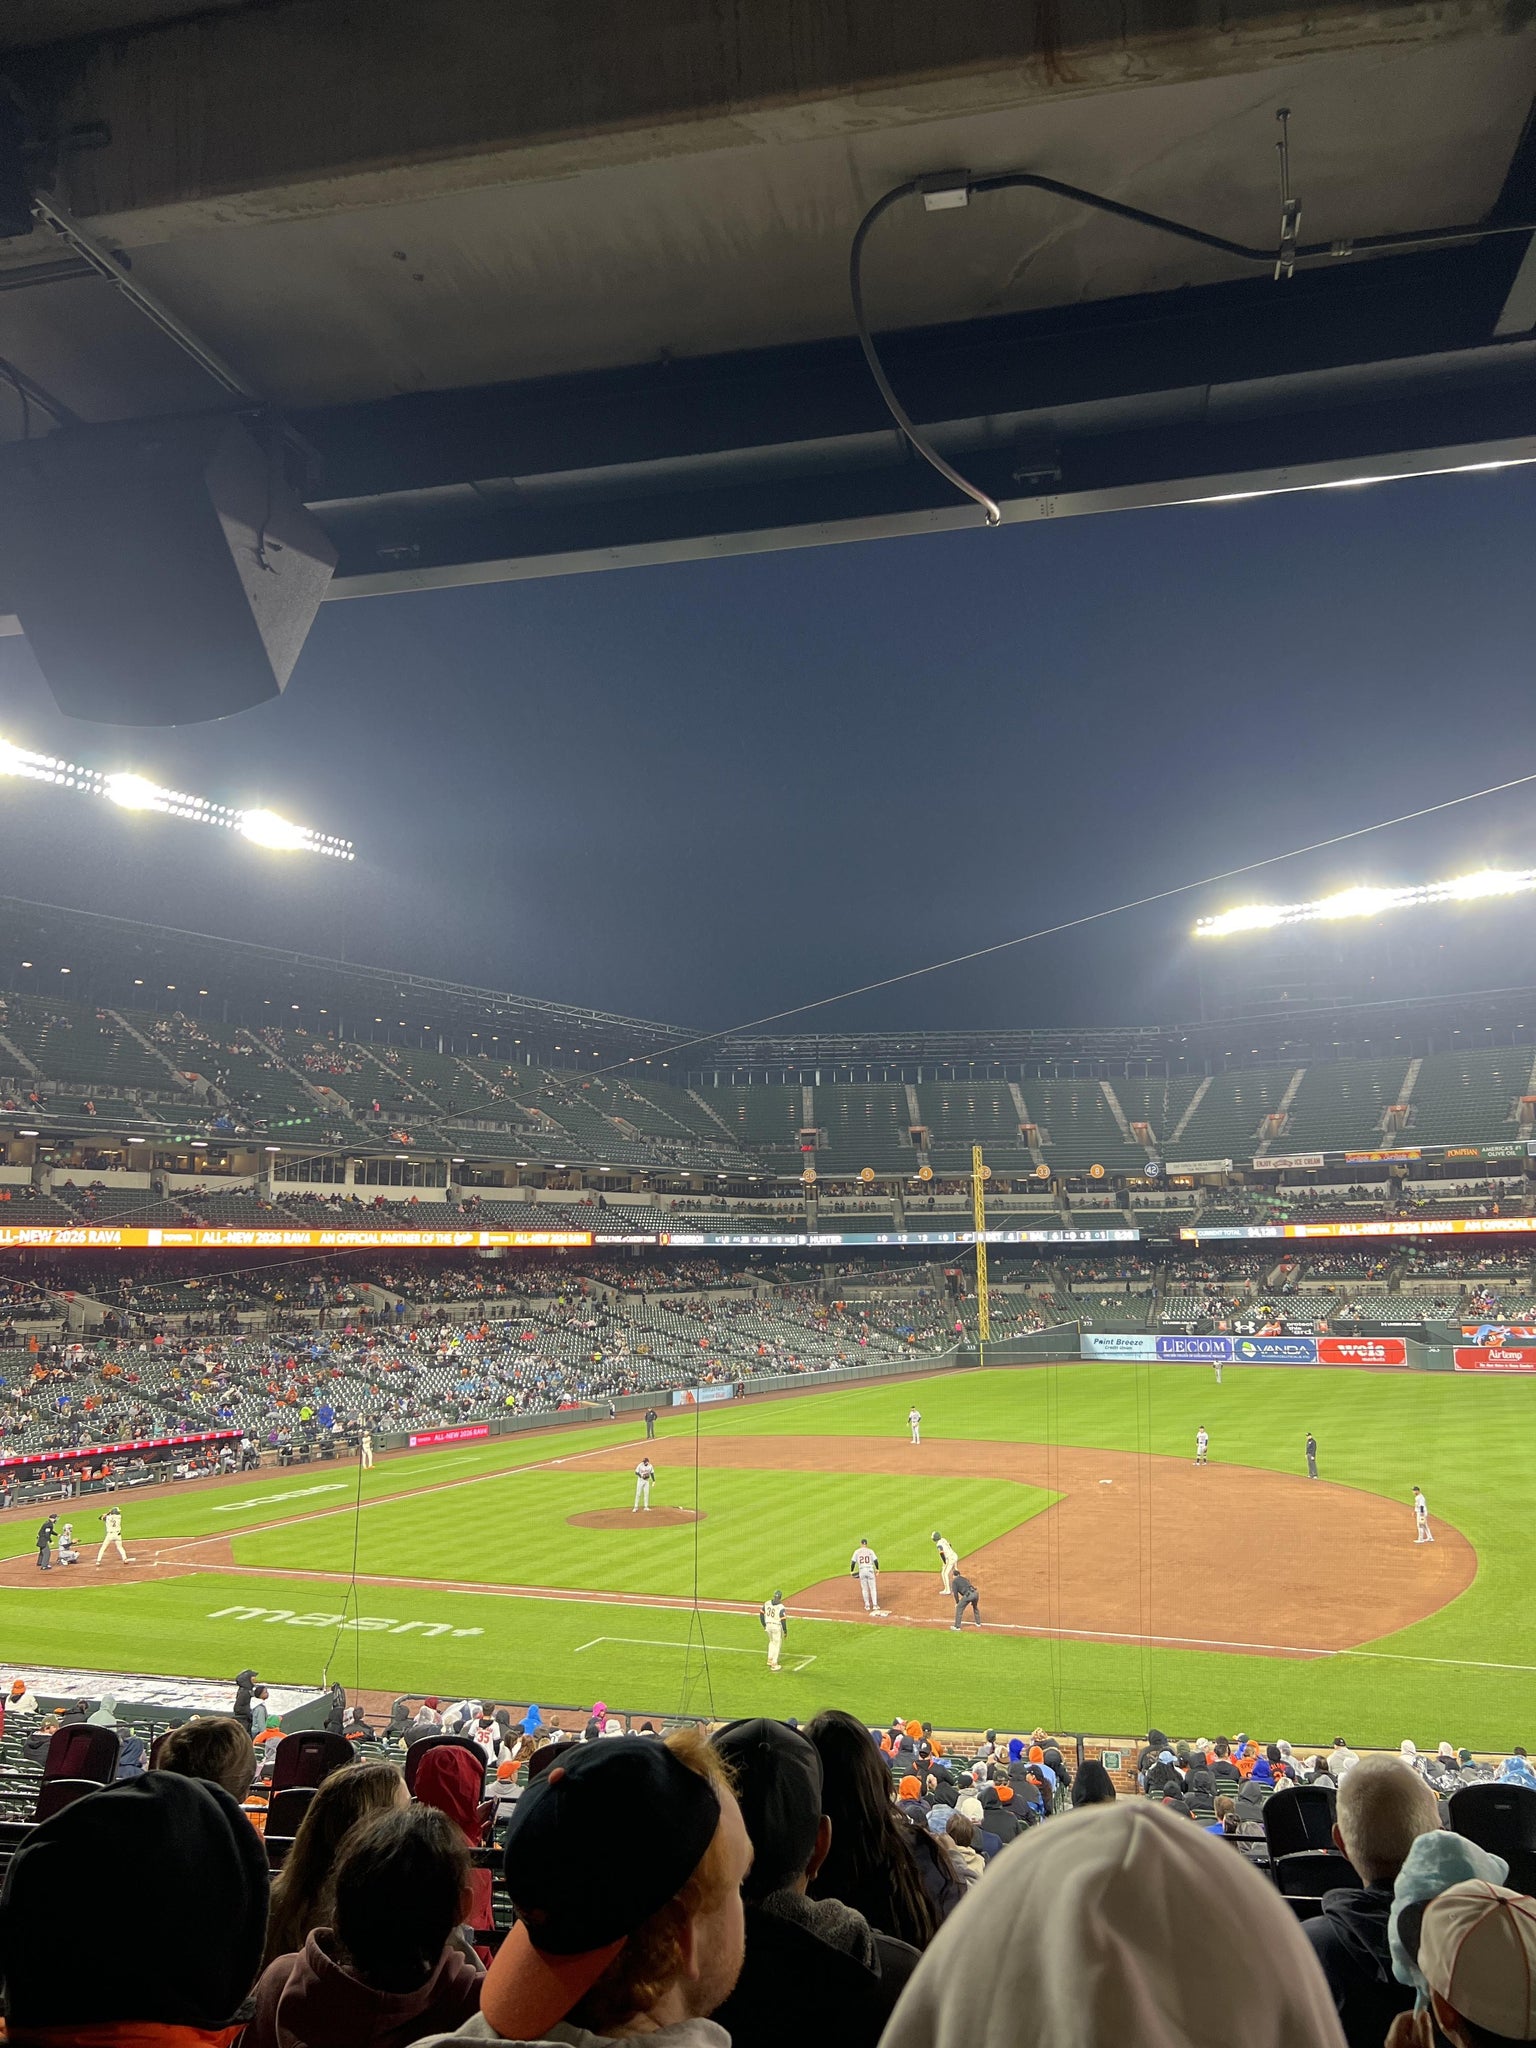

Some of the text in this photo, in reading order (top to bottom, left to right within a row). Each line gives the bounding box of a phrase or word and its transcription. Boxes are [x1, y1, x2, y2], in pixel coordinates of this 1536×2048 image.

[1447, 1148, 1479, 1158] POMPEIAN
[1256, 1160, 1271, 1168] ENJOY
[1304, 1157, 1321, 1165] CREAM
[804, 1171, 814, 1179] 20
[1038, 1167, 1048, 1175] 33
[1146, 1166, 1157, 1174] 42
[55, 1229, 87, 1244] 2026
[88, 1230, 121, 1244] RAV4
[1224, 1228, 1242, 1236] TOTAL
[202, 1231, 255, 1244] ALL-NEW
[421, 1233, 435, 1244] OF
[435, 1233, 453, 1244] THE
[1116, 1338, 1144, 1346] Breeze
[1162, 1340, 1225, 1353] LECOM
[1256, 1345, 1310, 1355] VANDA
[1337, 1341, 1385, 1357] weis
[1489, 1349, 1523, 1361] Airtemp
[859, 1555, 870, 1564] 20
[766, 1606, 776, 1618] 36
[477, 1731, 491, 1744] 35
